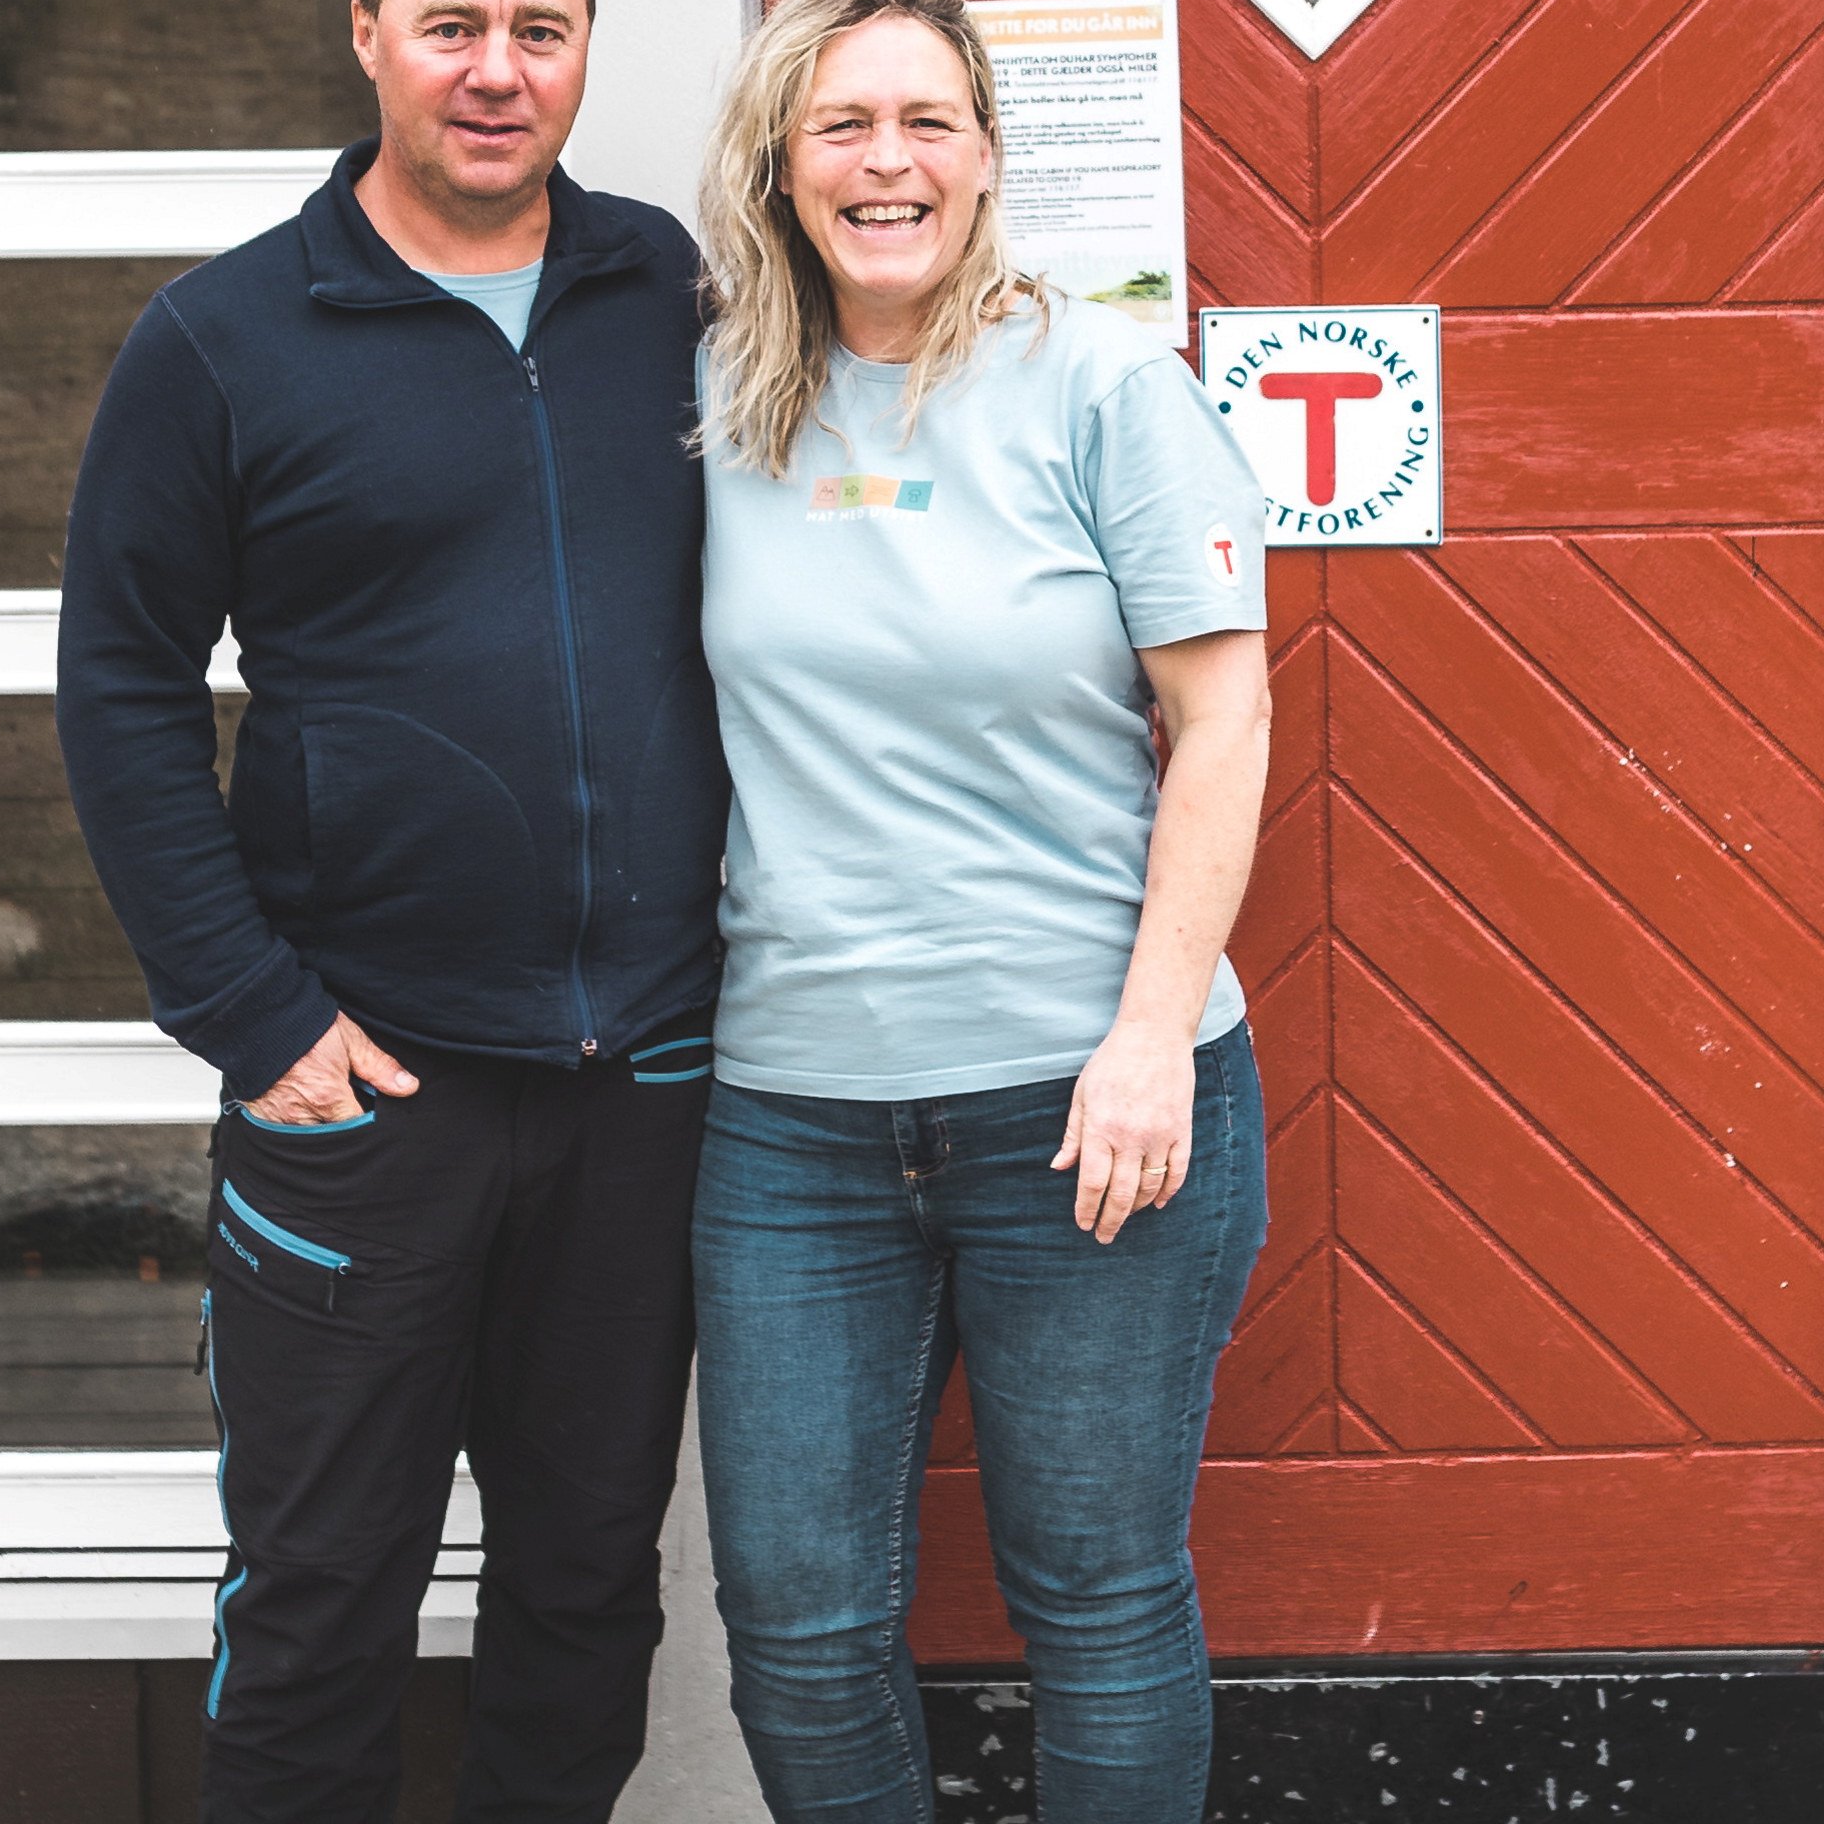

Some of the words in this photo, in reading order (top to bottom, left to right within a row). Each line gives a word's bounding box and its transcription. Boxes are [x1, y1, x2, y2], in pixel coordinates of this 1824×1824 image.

[1087, 11, 1125, 33] GÅR
[1020, 66, 1048, 76] DETTE
[1095, 61, 1124, 74] OGSÅ
[1075, 54, 1095, 63] HAR
[1096, 52, 1158, 62] SYMPTOMER
[1224, 332, 1285, 390] DEN
[1298, 320, 1419, 390] NORSKE
[1258, 371, 1384, 507] T
[1264, 426, 1430, 536] STFORENING
